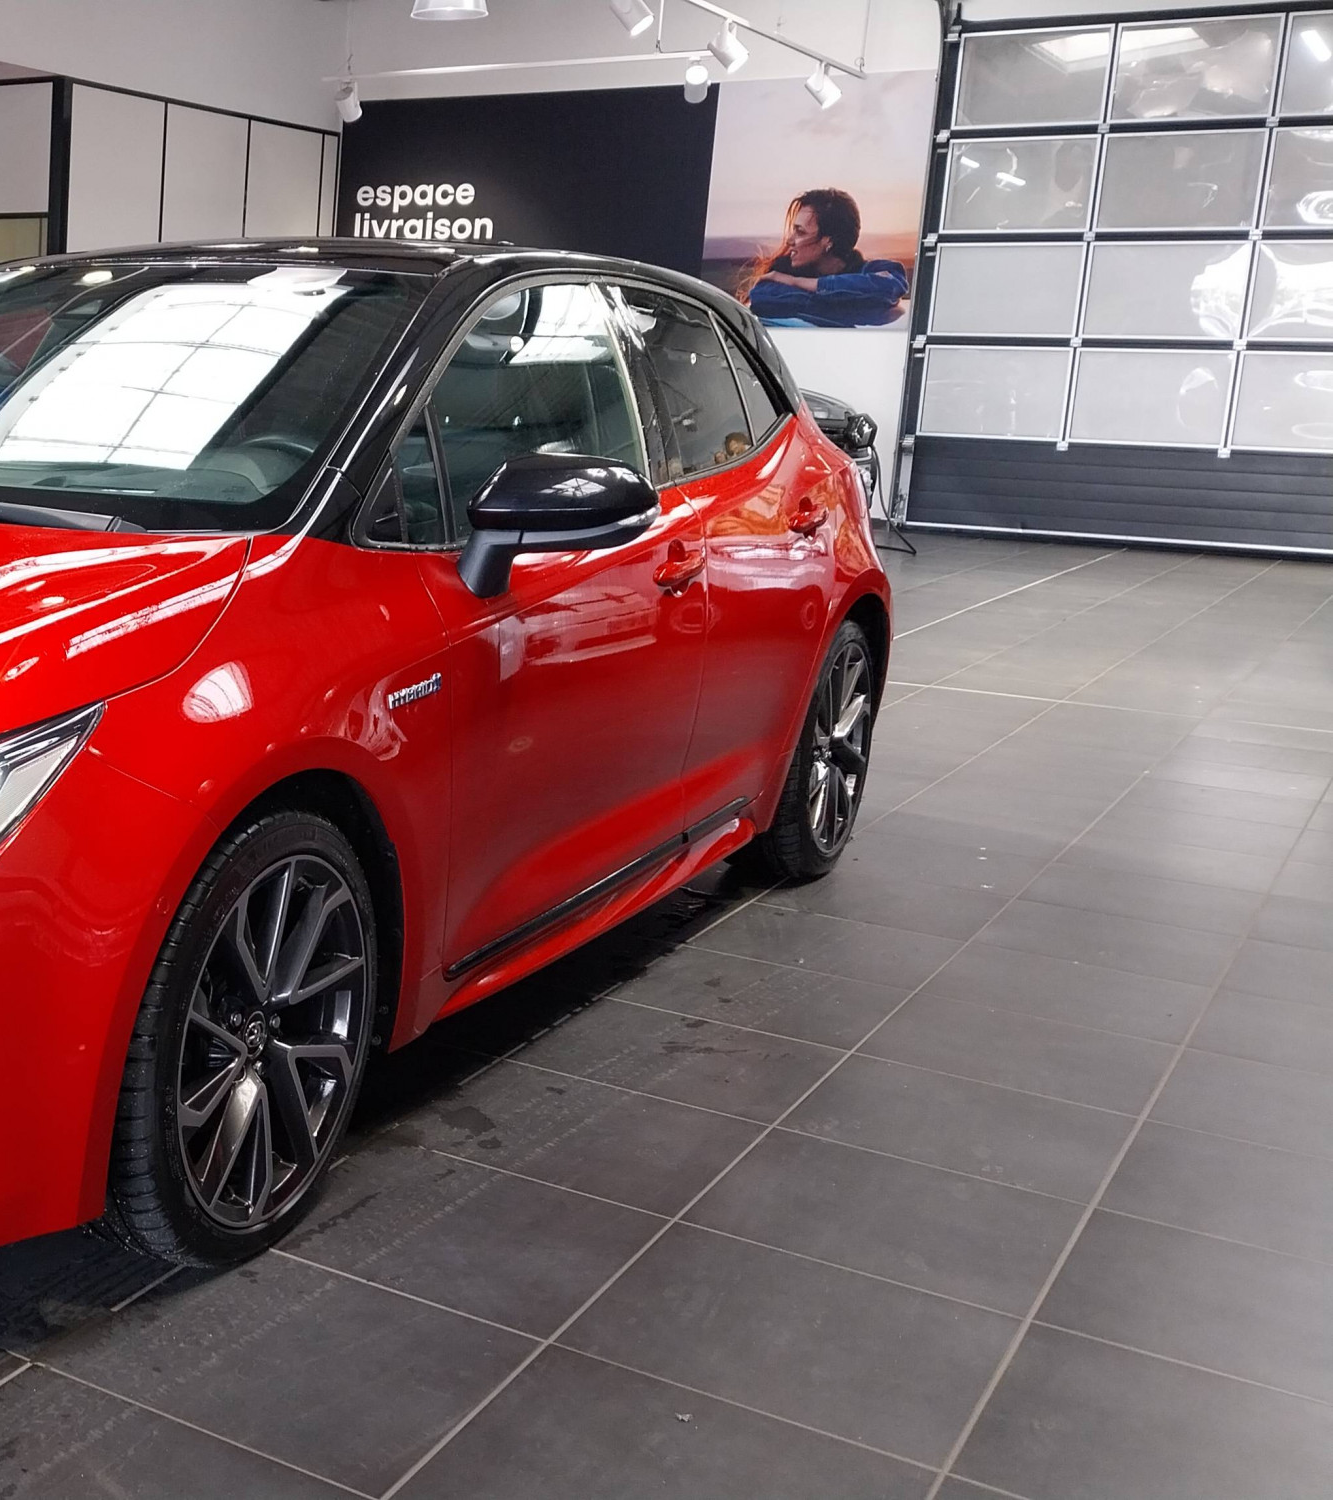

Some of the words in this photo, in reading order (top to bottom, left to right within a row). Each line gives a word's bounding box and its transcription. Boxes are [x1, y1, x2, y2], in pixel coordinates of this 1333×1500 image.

[356, 182, 475, 213] espace
[353, 211, 494, 240] livraison
[387, 678, 435, 710] HYBRID
